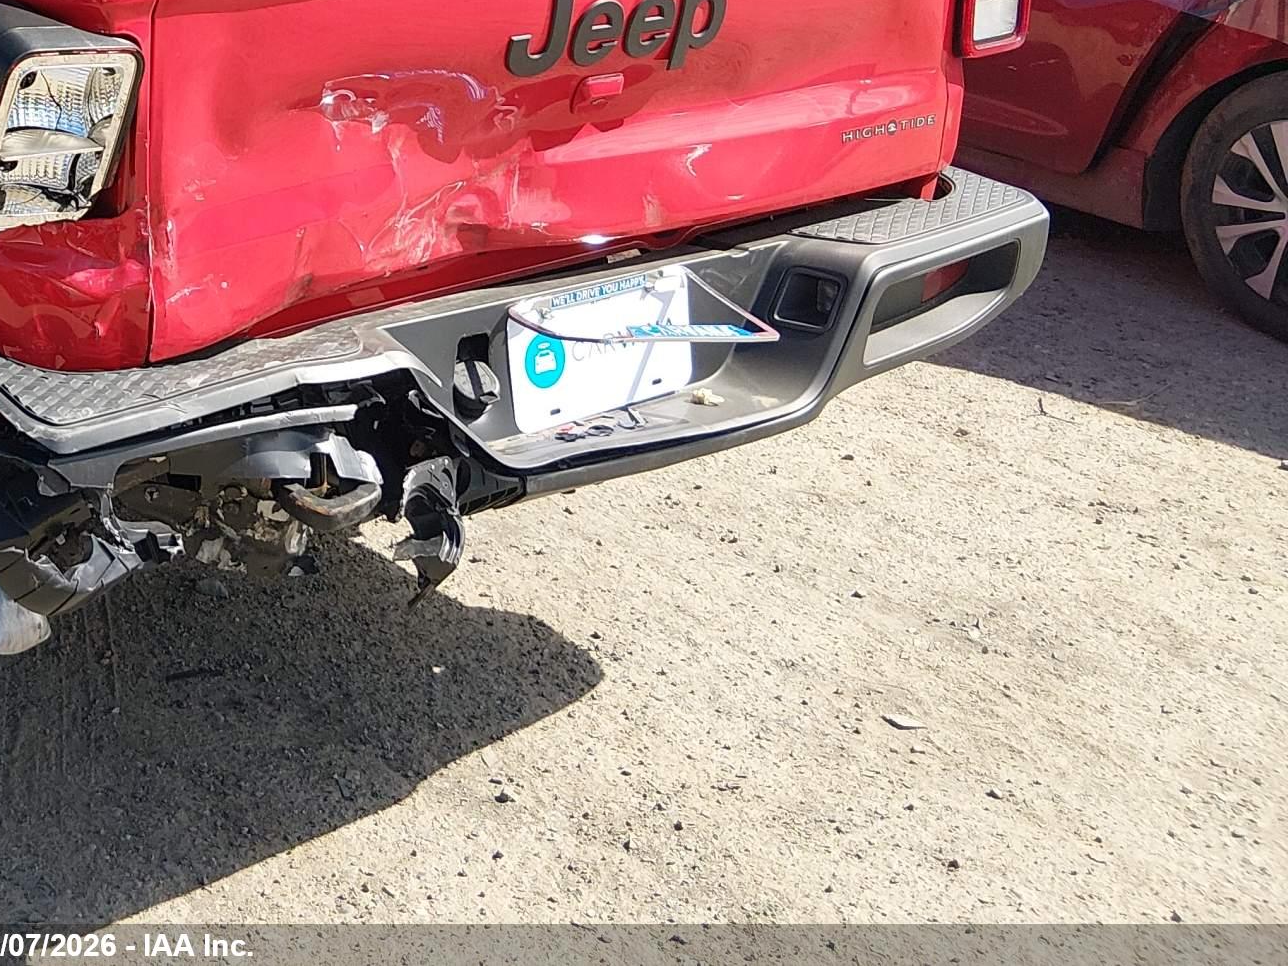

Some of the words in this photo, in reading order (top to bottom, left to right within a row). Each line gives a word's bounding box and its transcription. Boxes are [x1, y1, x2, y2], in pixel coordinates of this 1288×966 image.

[842, 124, 885, 143] HIGH
[900, 114, 936, 130] TIDE
[552, 294, 576, 307] WE'LL
[576, 287, 601, 301] DRIVE
[601, 282, 619, 295] YOU
